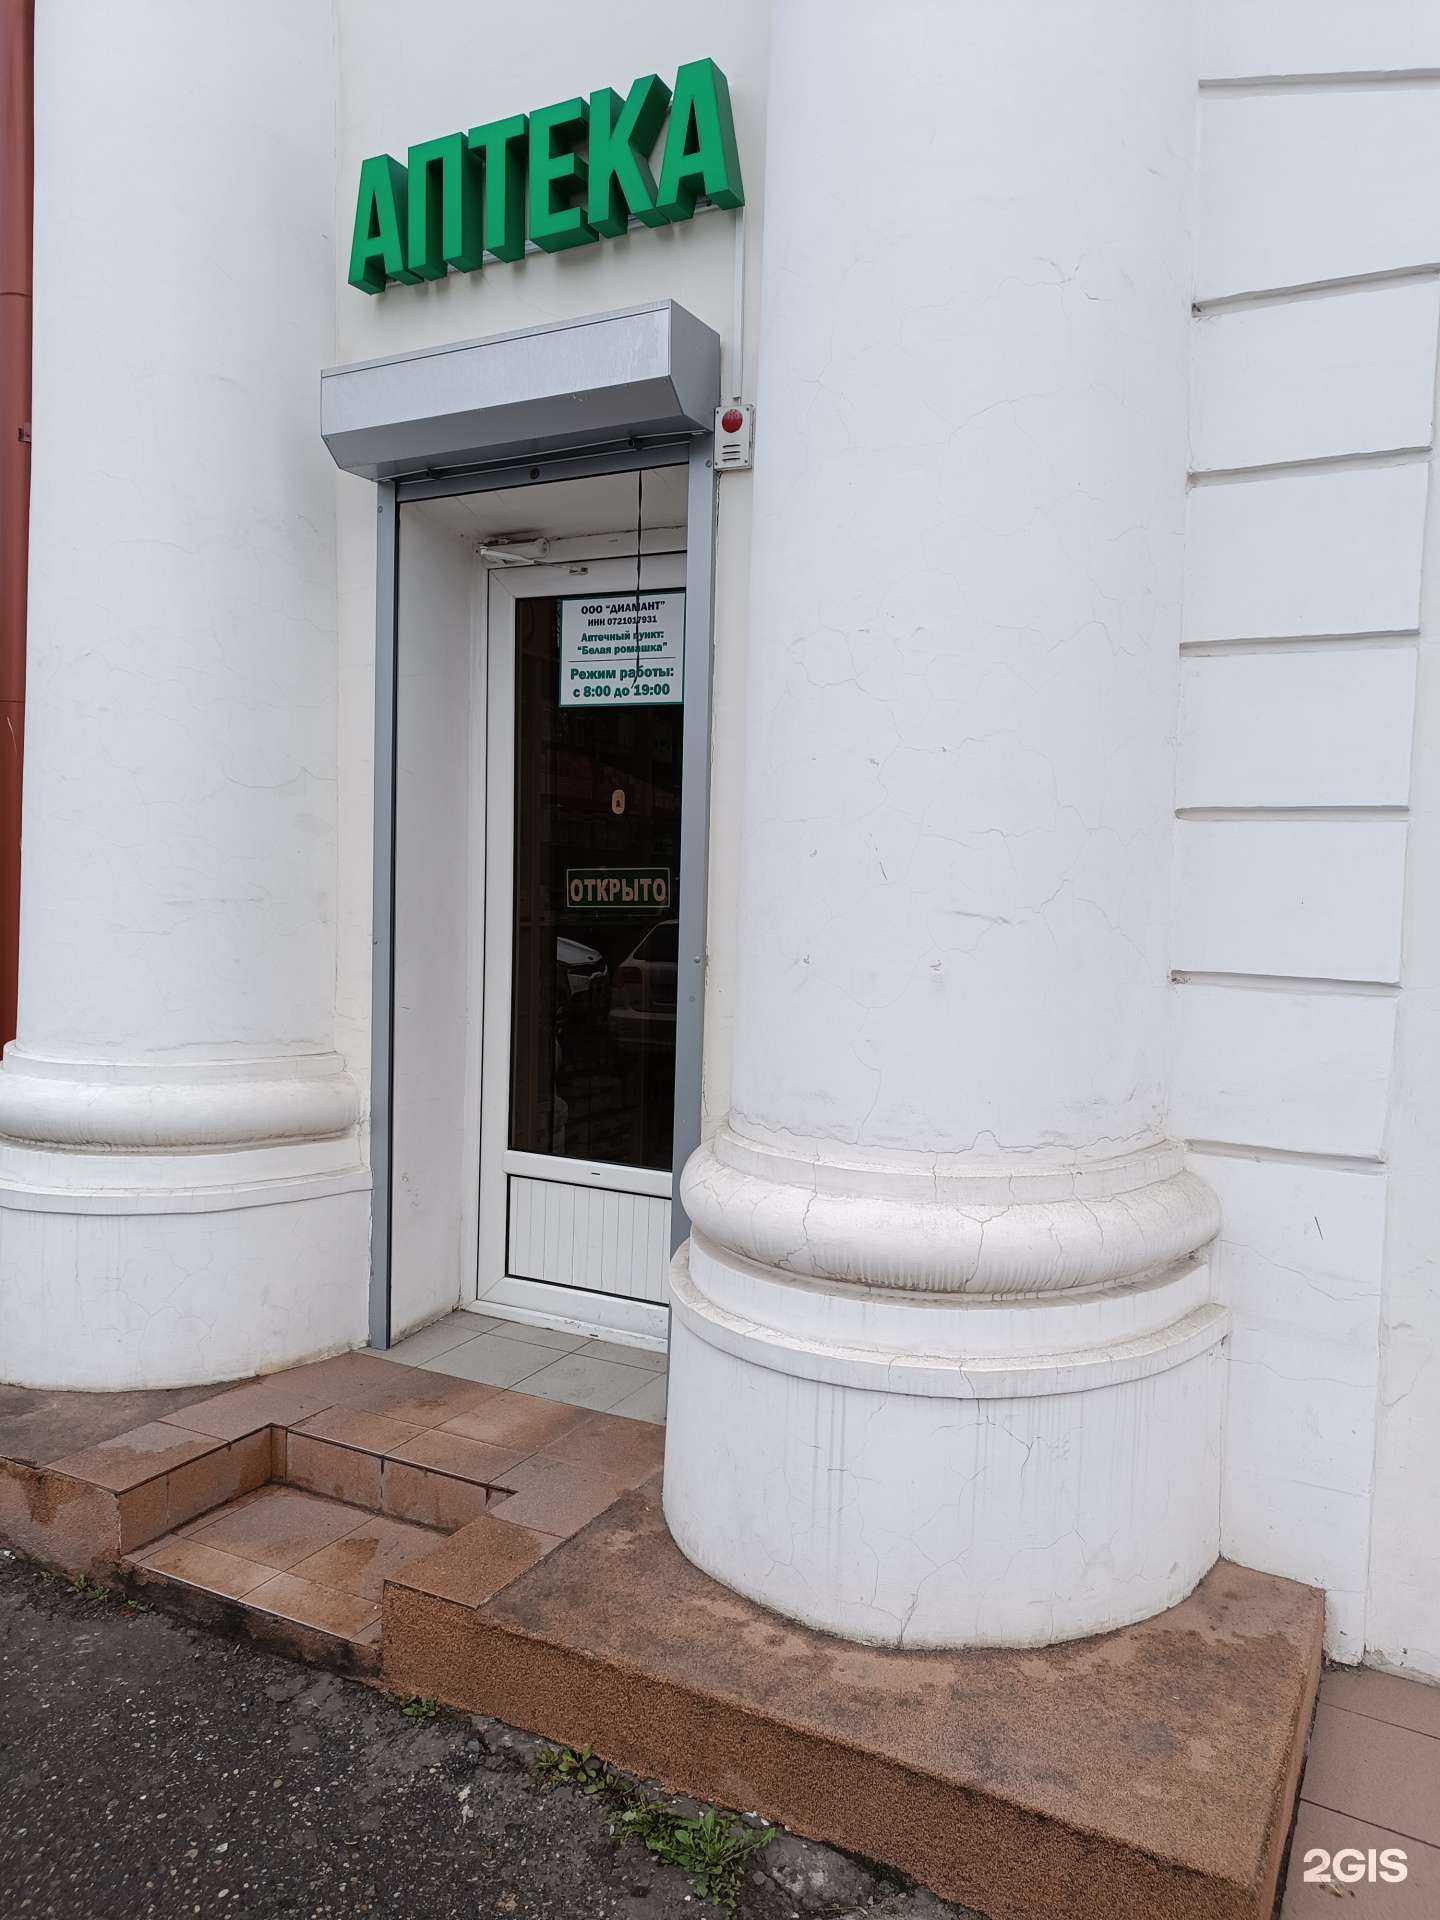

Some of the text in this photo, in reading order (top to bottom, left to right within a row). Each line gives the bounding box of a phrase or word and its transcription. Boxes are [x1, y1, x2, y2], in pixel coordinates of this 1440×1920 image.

[348, 57, 744, 295] АПТЕКА
[581, 605, 603, 615] ООО
[588, 618, 605, 627] ИНН
[581, 631, 630, 642] Аптечный
[577, 642, 667, 655] "Белая ромашка"
[570, 665, 674, 681] Режим работы:
[573, 683, 670, 698] с 8:00 до 19:00
[570, 878, 667, 902] ОТКРЫТО
